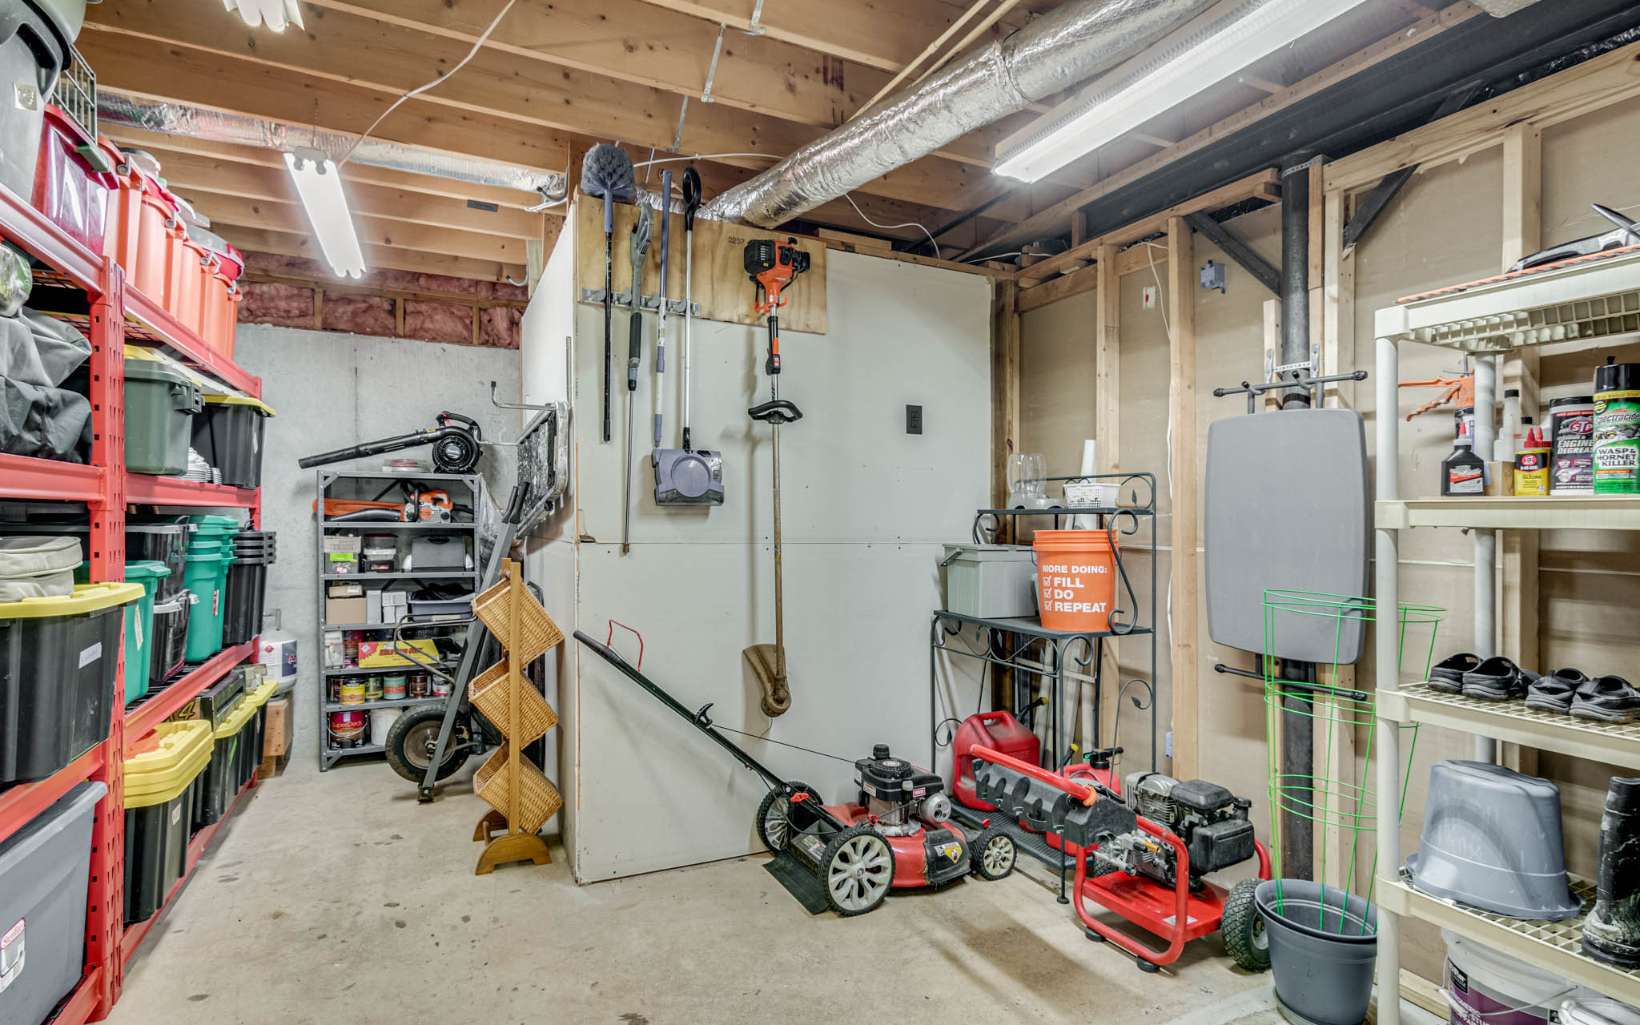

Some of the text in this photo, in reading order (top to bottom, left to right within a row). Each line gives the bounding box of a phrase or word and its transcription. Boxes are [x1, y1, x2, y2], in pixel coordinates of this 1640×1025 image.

[1598, 447, 1629, 455] WASP
[1042, 565, 1068, 573] MORE
[1053, 577, 1085, 588] FILL
[1054, 589, 1074, 600] DO
[1054, 601, 1107, 613] REPEAT
